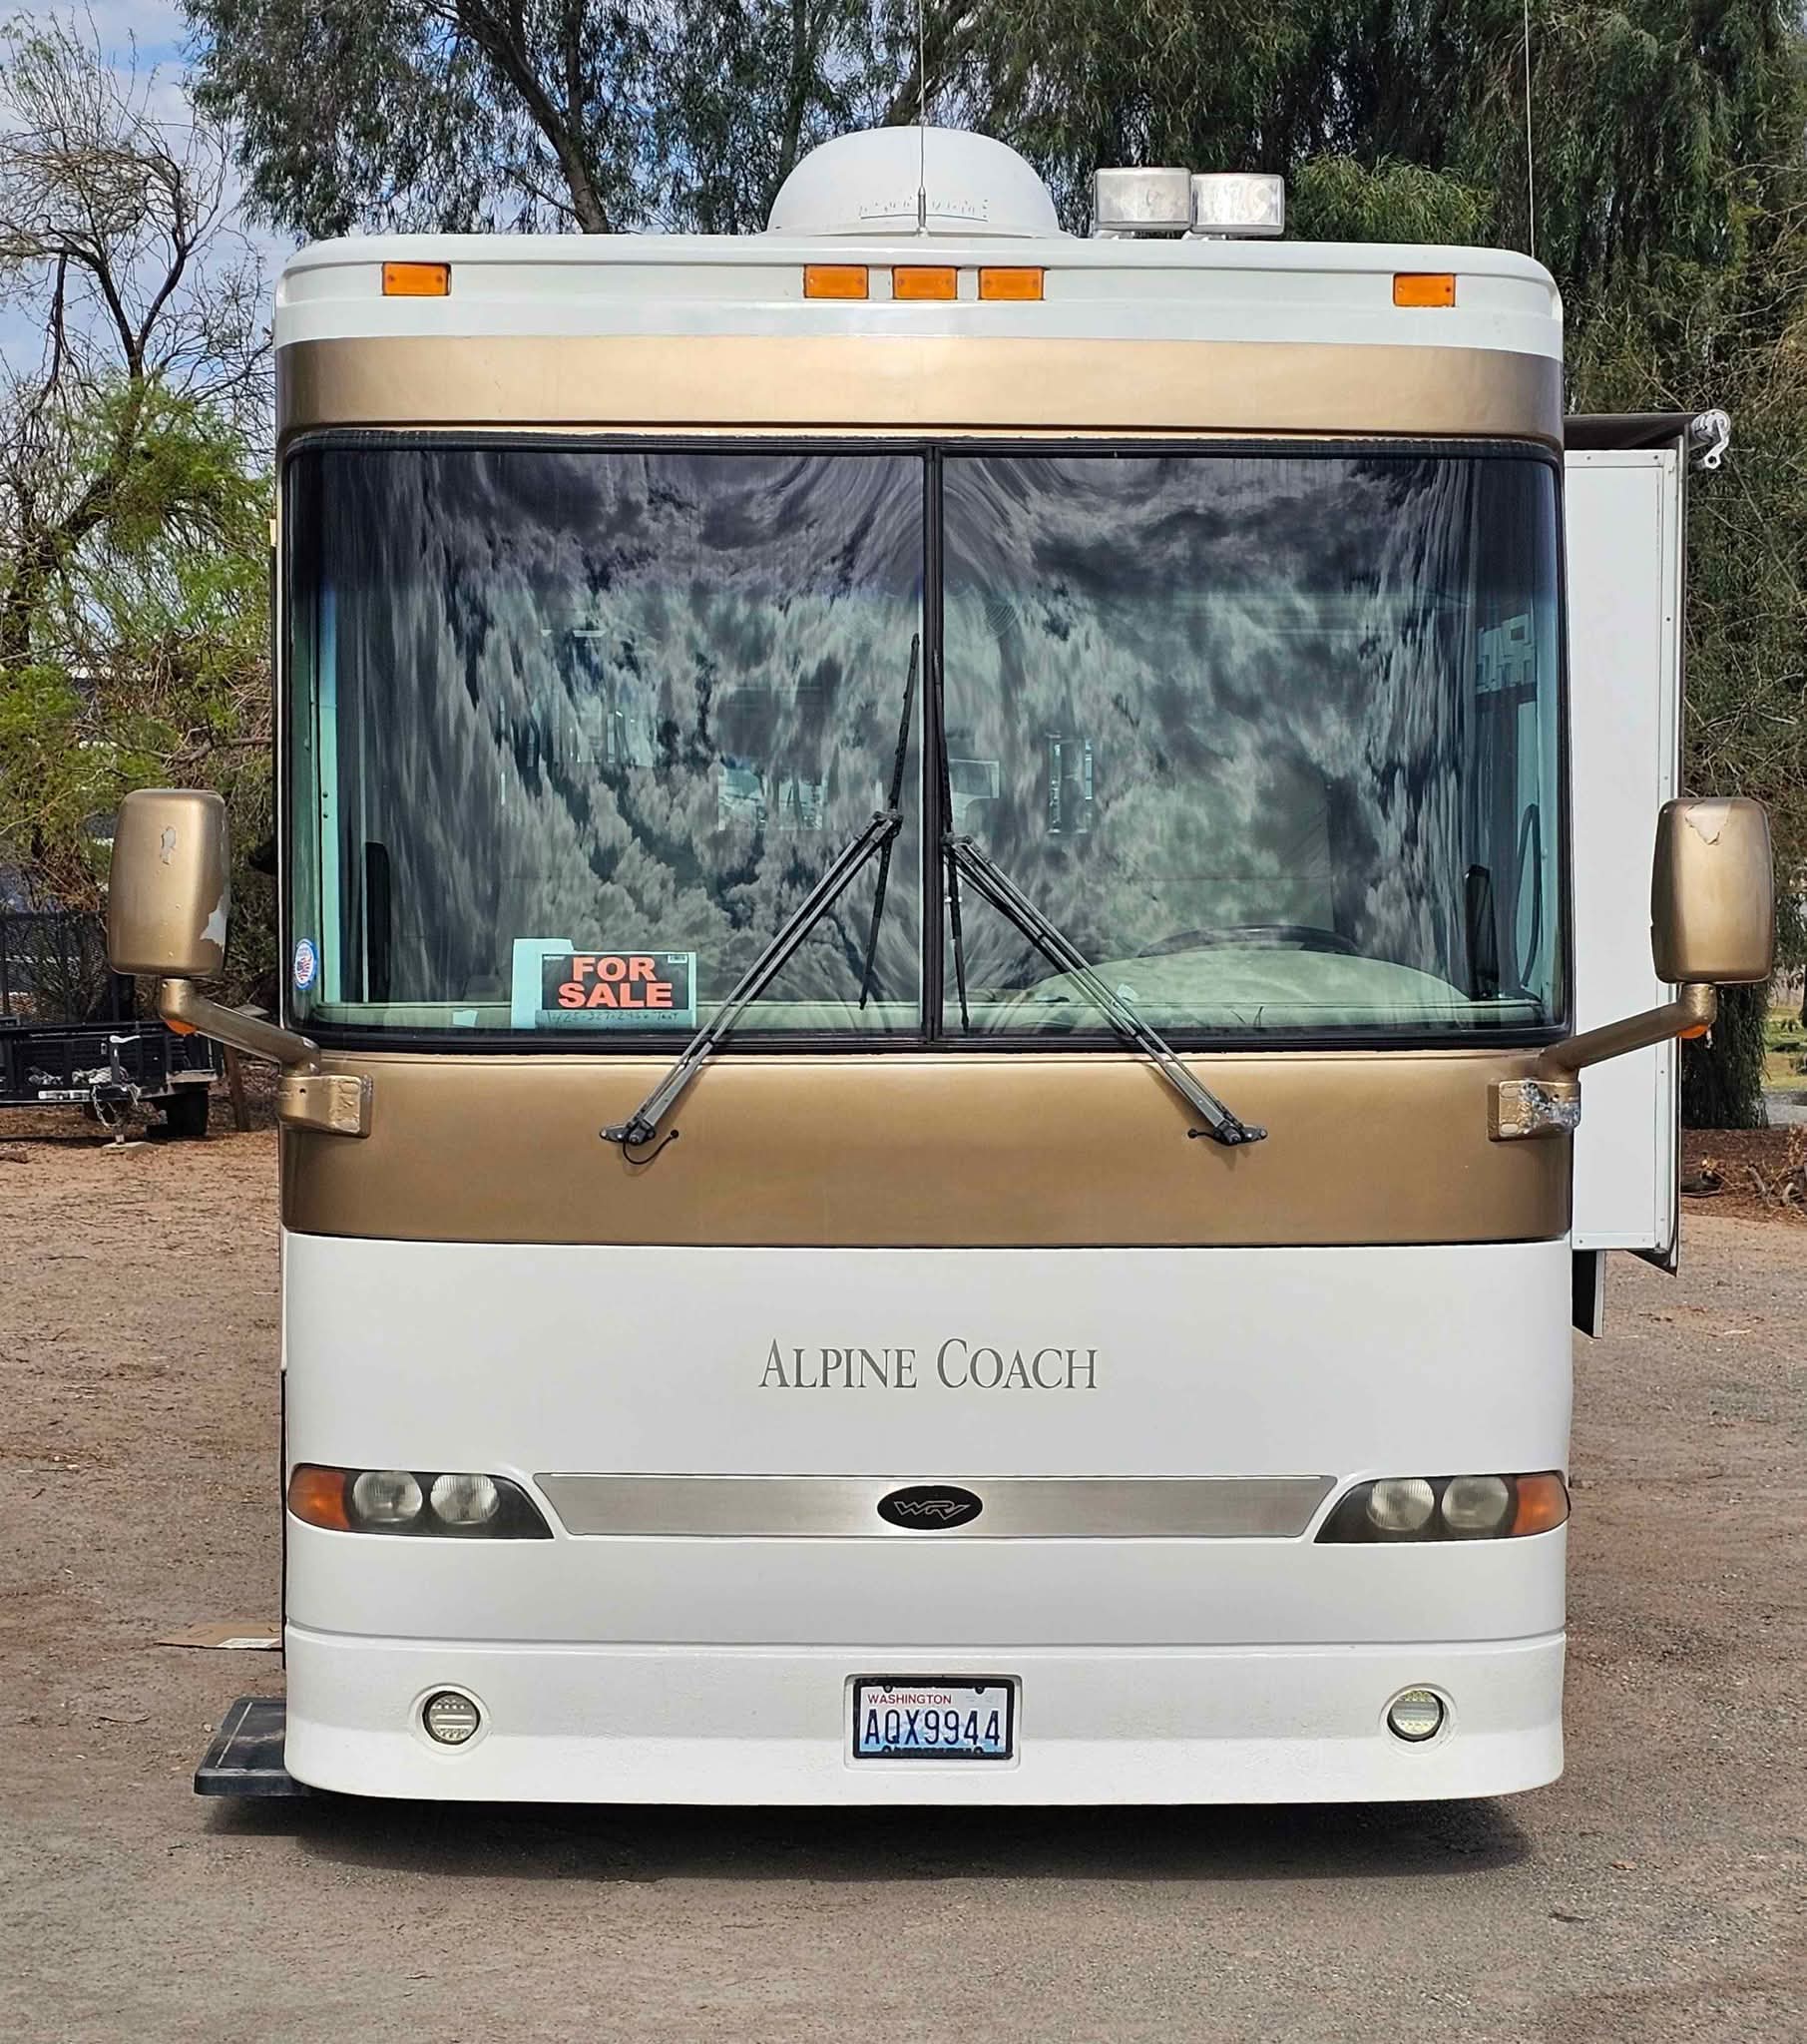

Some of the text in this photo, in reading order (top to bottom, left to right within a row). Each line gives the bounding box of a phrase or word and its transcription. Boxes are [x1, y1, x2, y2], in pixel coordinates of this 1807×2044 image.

[573, 956, 657, 981] FOR
[558, 982, 674, 1008] SALE
[758, 1337, 1099, 1389] ALPINE COACH
[868, 1694, 952, 1705] WASHINGTON
[864, 1709, 1001, 1746] AQX9944
